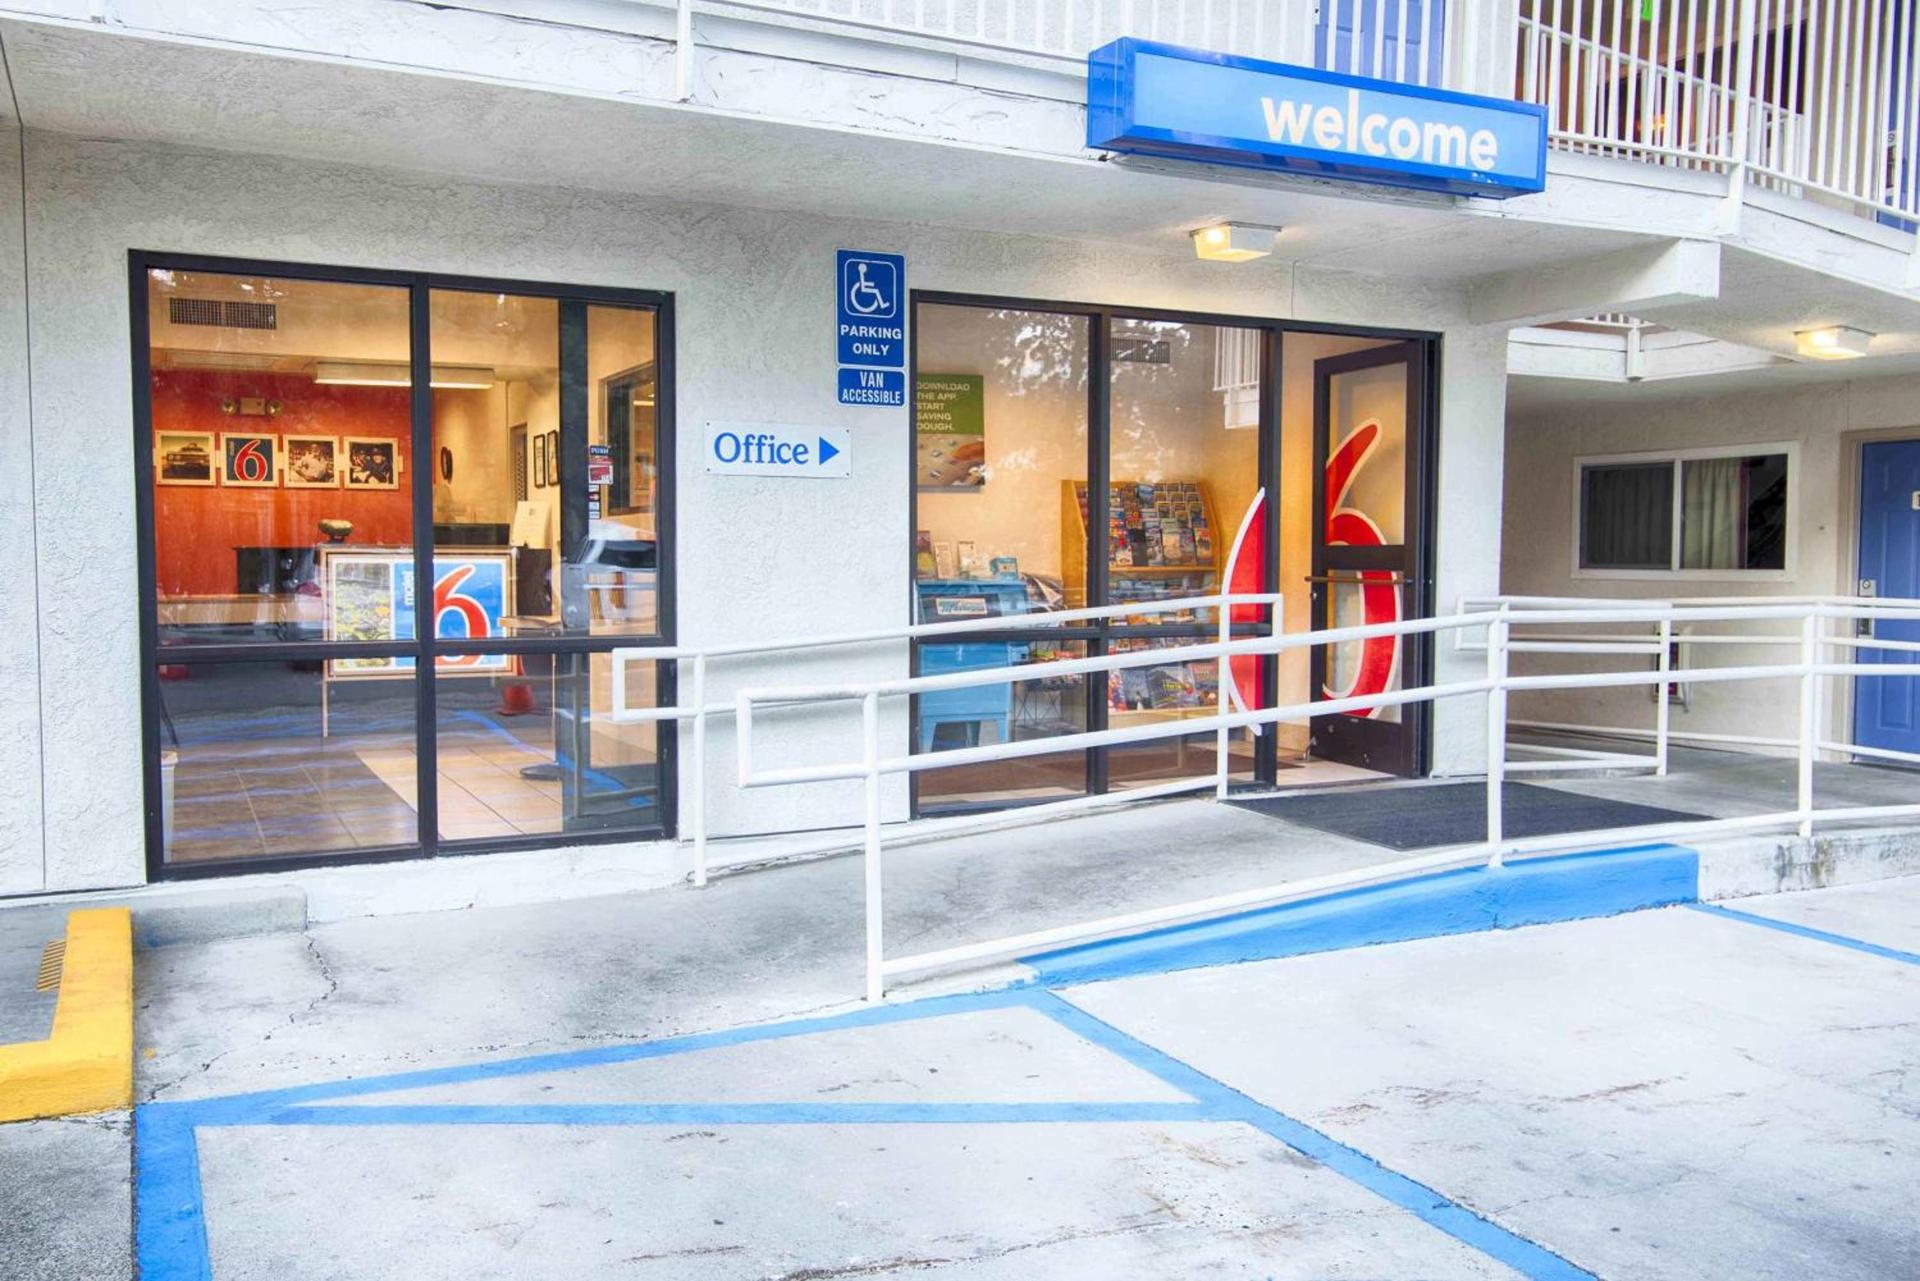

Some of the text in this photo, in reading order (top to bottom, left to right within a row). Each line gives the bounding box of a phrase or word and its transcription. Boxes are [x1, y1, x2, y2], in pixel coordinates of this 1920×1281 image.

[1261, 89, 1498, 170] welcome
[840, 324, 902, 340] PARKING
[852, 343, 890, 356] ONLY
[859, 371, 884, 389] VAN
[841, 388, 901, 405] ACCESSIBLE
[917, 402, 945, 410] START
[917, 412, 952, 421] SAVING
[713, 432, 809, 465] Office
[234, 439, 268, 481] 6
